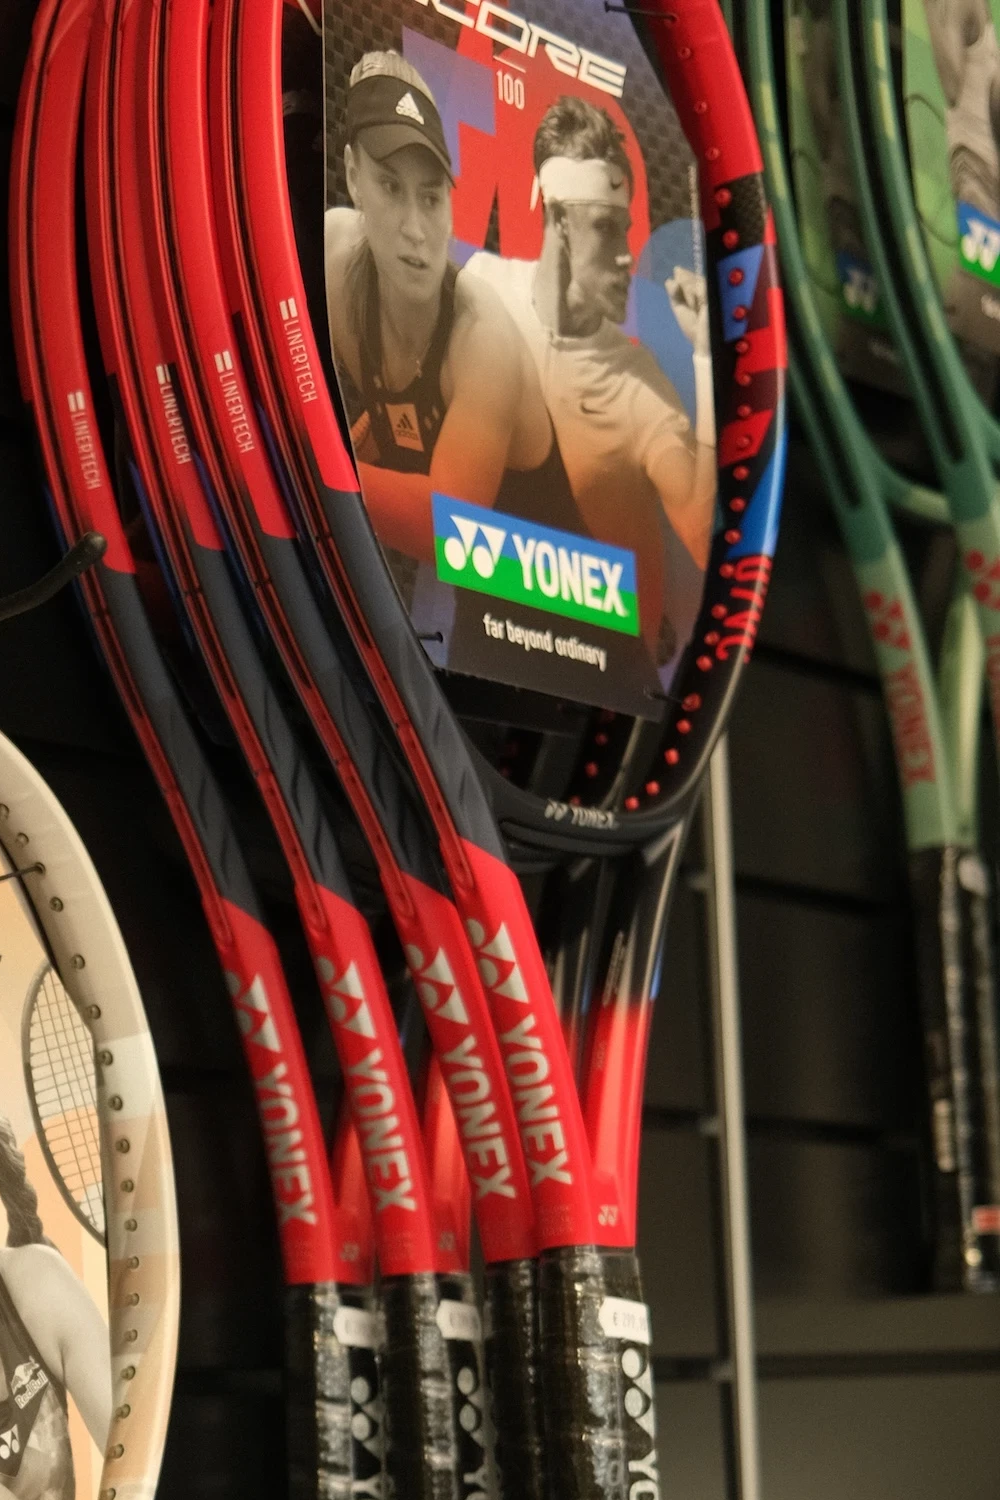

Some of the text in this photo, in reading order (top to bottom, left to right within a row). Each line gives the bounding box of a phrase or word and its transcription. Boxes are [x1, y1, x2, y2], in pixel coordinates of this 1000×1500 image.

[412, 0, 627, 98] CORE
[495, 69, 526, 111] 100
[284, 320, 319, 404] LINERTECH
[71, 412, 102, 490] LINERTECH
[159, 385, 191, 465] LINERTECH
[219, 371, 256, 454] LINERTECH
[511, 533, 628, 618] YONEX
[483, 613, 608, 672] far beyond ordinary
[348, 1048, 418, 1213] YONEX
[441, 1034, 516, 1200] YONEX
[501, 1014, 572, 1186] YONEX
[255, 1062, 318, 1227] YONEX
